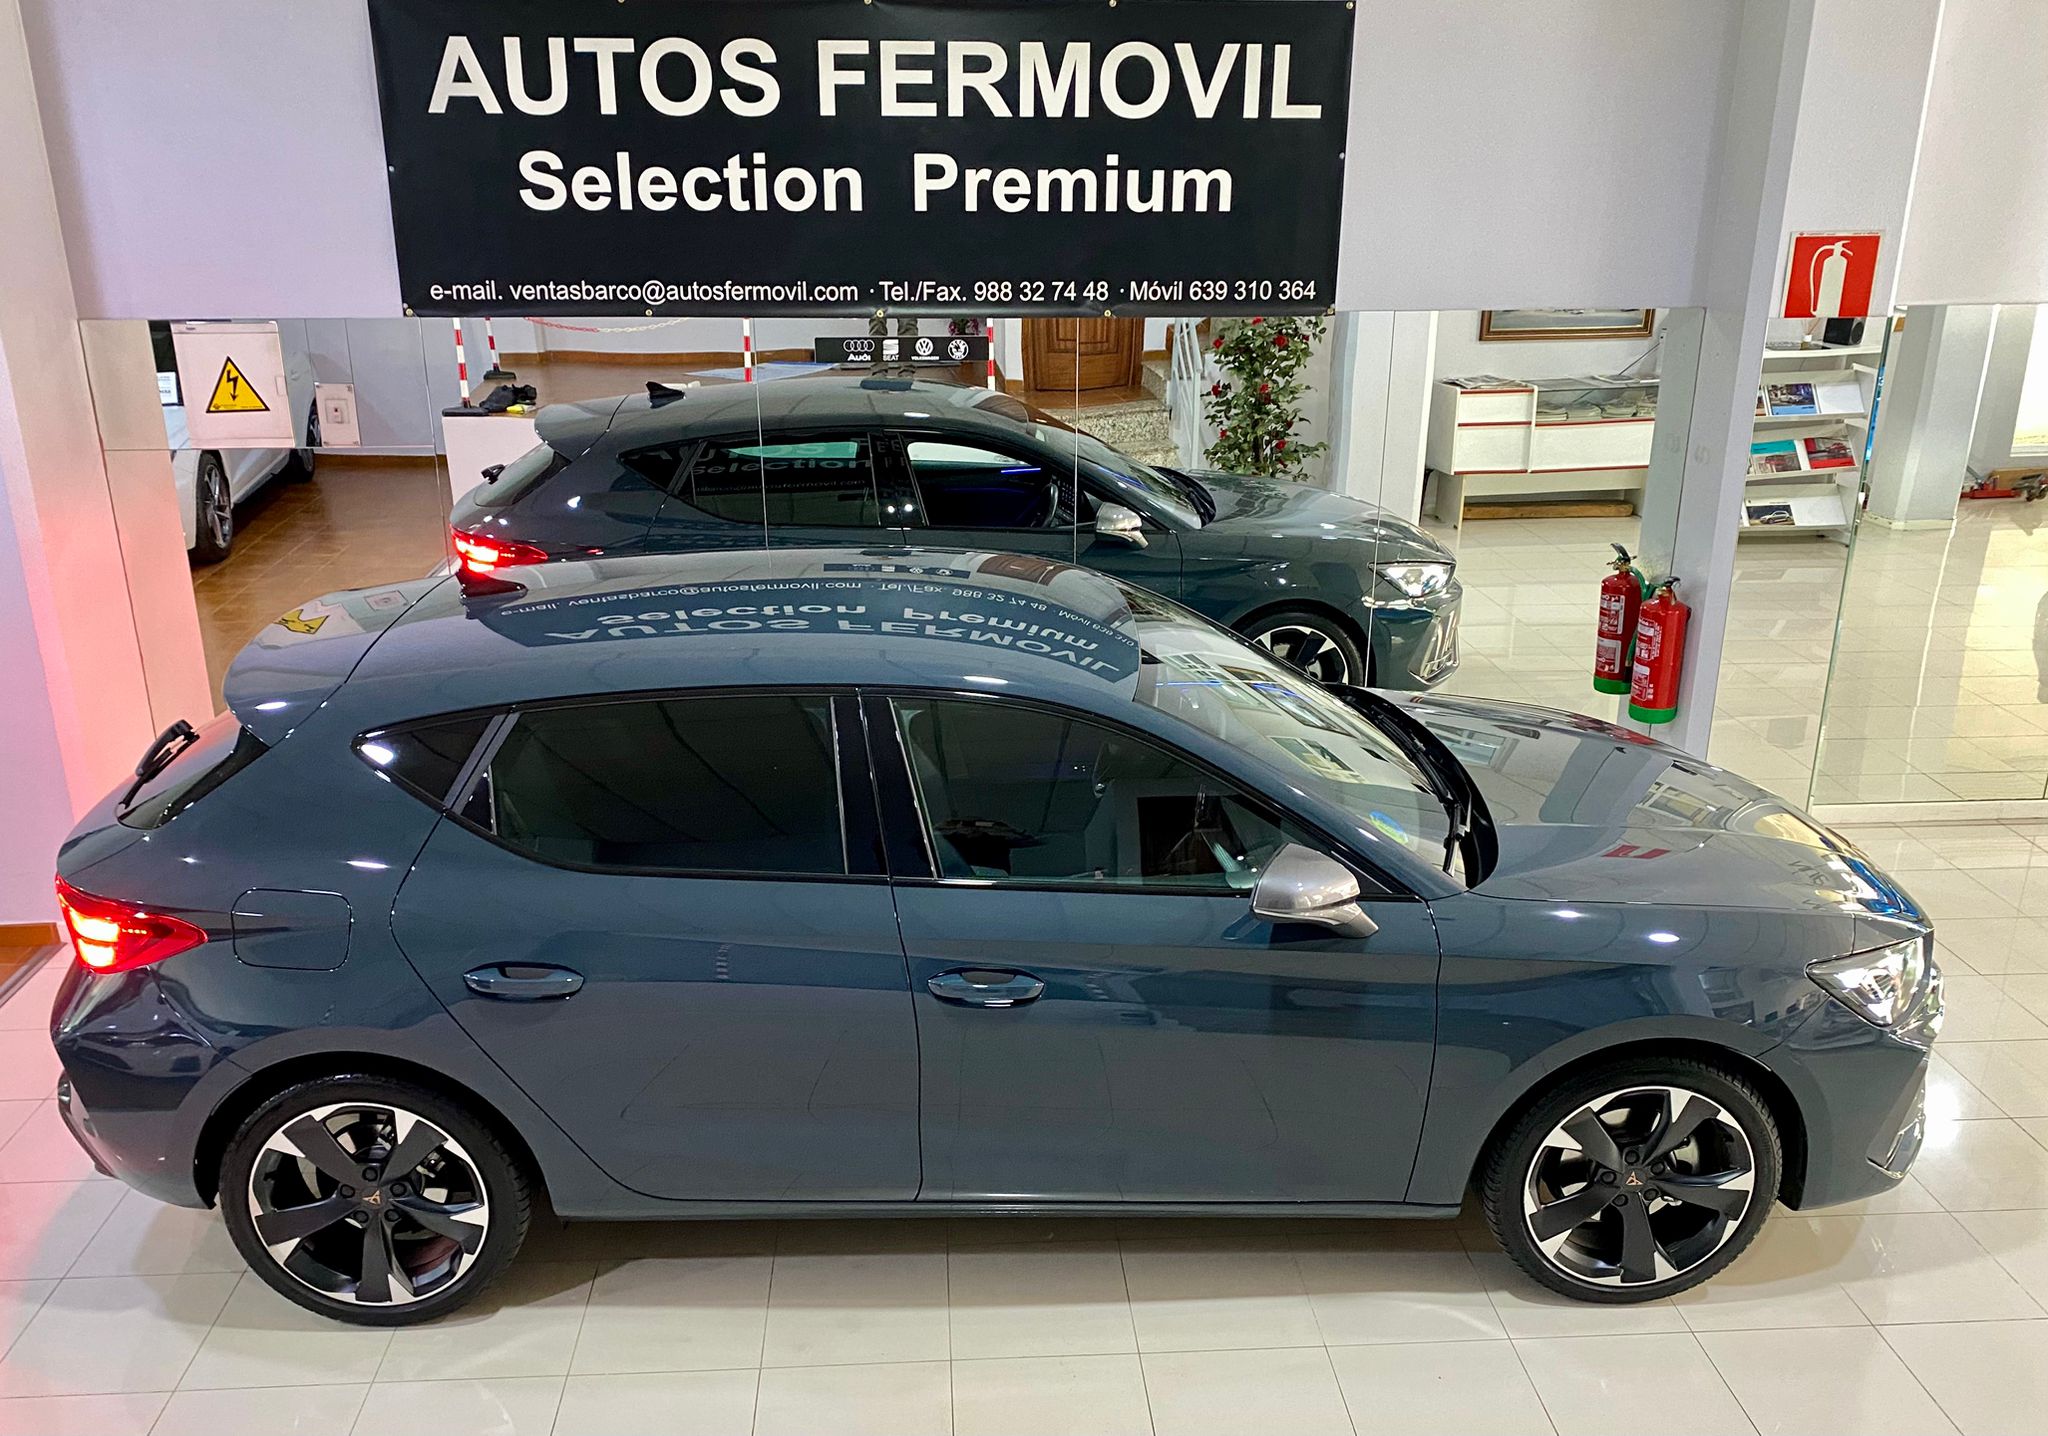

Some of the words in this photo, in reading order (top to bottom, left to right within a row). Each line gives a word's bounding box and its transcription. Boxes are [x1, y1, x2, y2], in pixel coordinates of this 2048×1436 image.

[428, 35, 781, 117] AUTOS
[817, 39, 1322, 120] FERMOVIL
[518, 150, 863, 212] Selection
[913, 152, 1233, 213] Premium
[429, 280, 503, 301] e-mail.
[509, 280, 859, 305] ventasbarco@autosfermovil.com
[973, 281, 1013, 302] 988
[1019, 281, 1045, 302] 32
[1051, 281, 1077, 302] 74
[1083, 281, 1109, 302] 48
[1130, 280, 1183, 301] Móvil
[1189, 281, 1228, 301] 639
[1234, 281, 1273, 301] 310
[1278, 281, 1317, 301] 364
[847, 353, 872, 361] Audi
